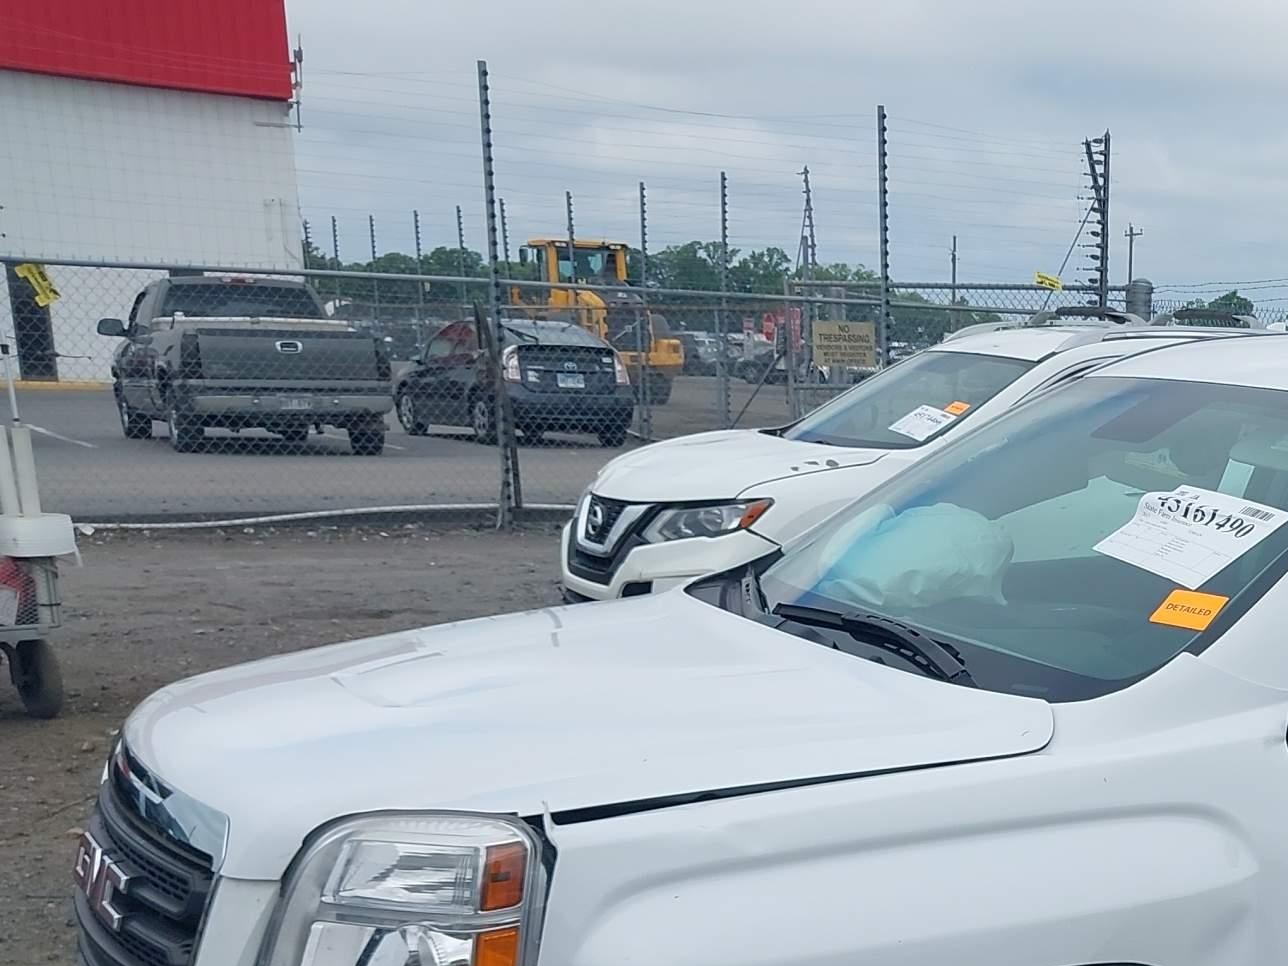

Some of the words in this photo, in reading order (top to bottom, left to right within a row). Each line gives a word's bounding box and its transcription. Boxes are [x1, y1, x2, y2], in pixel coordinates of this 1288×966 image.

[838, 324, 850, 333] NO
[818, 332, 870, 344] TRESPASSING
[1166, 602, 1213, 617] DETAILED
